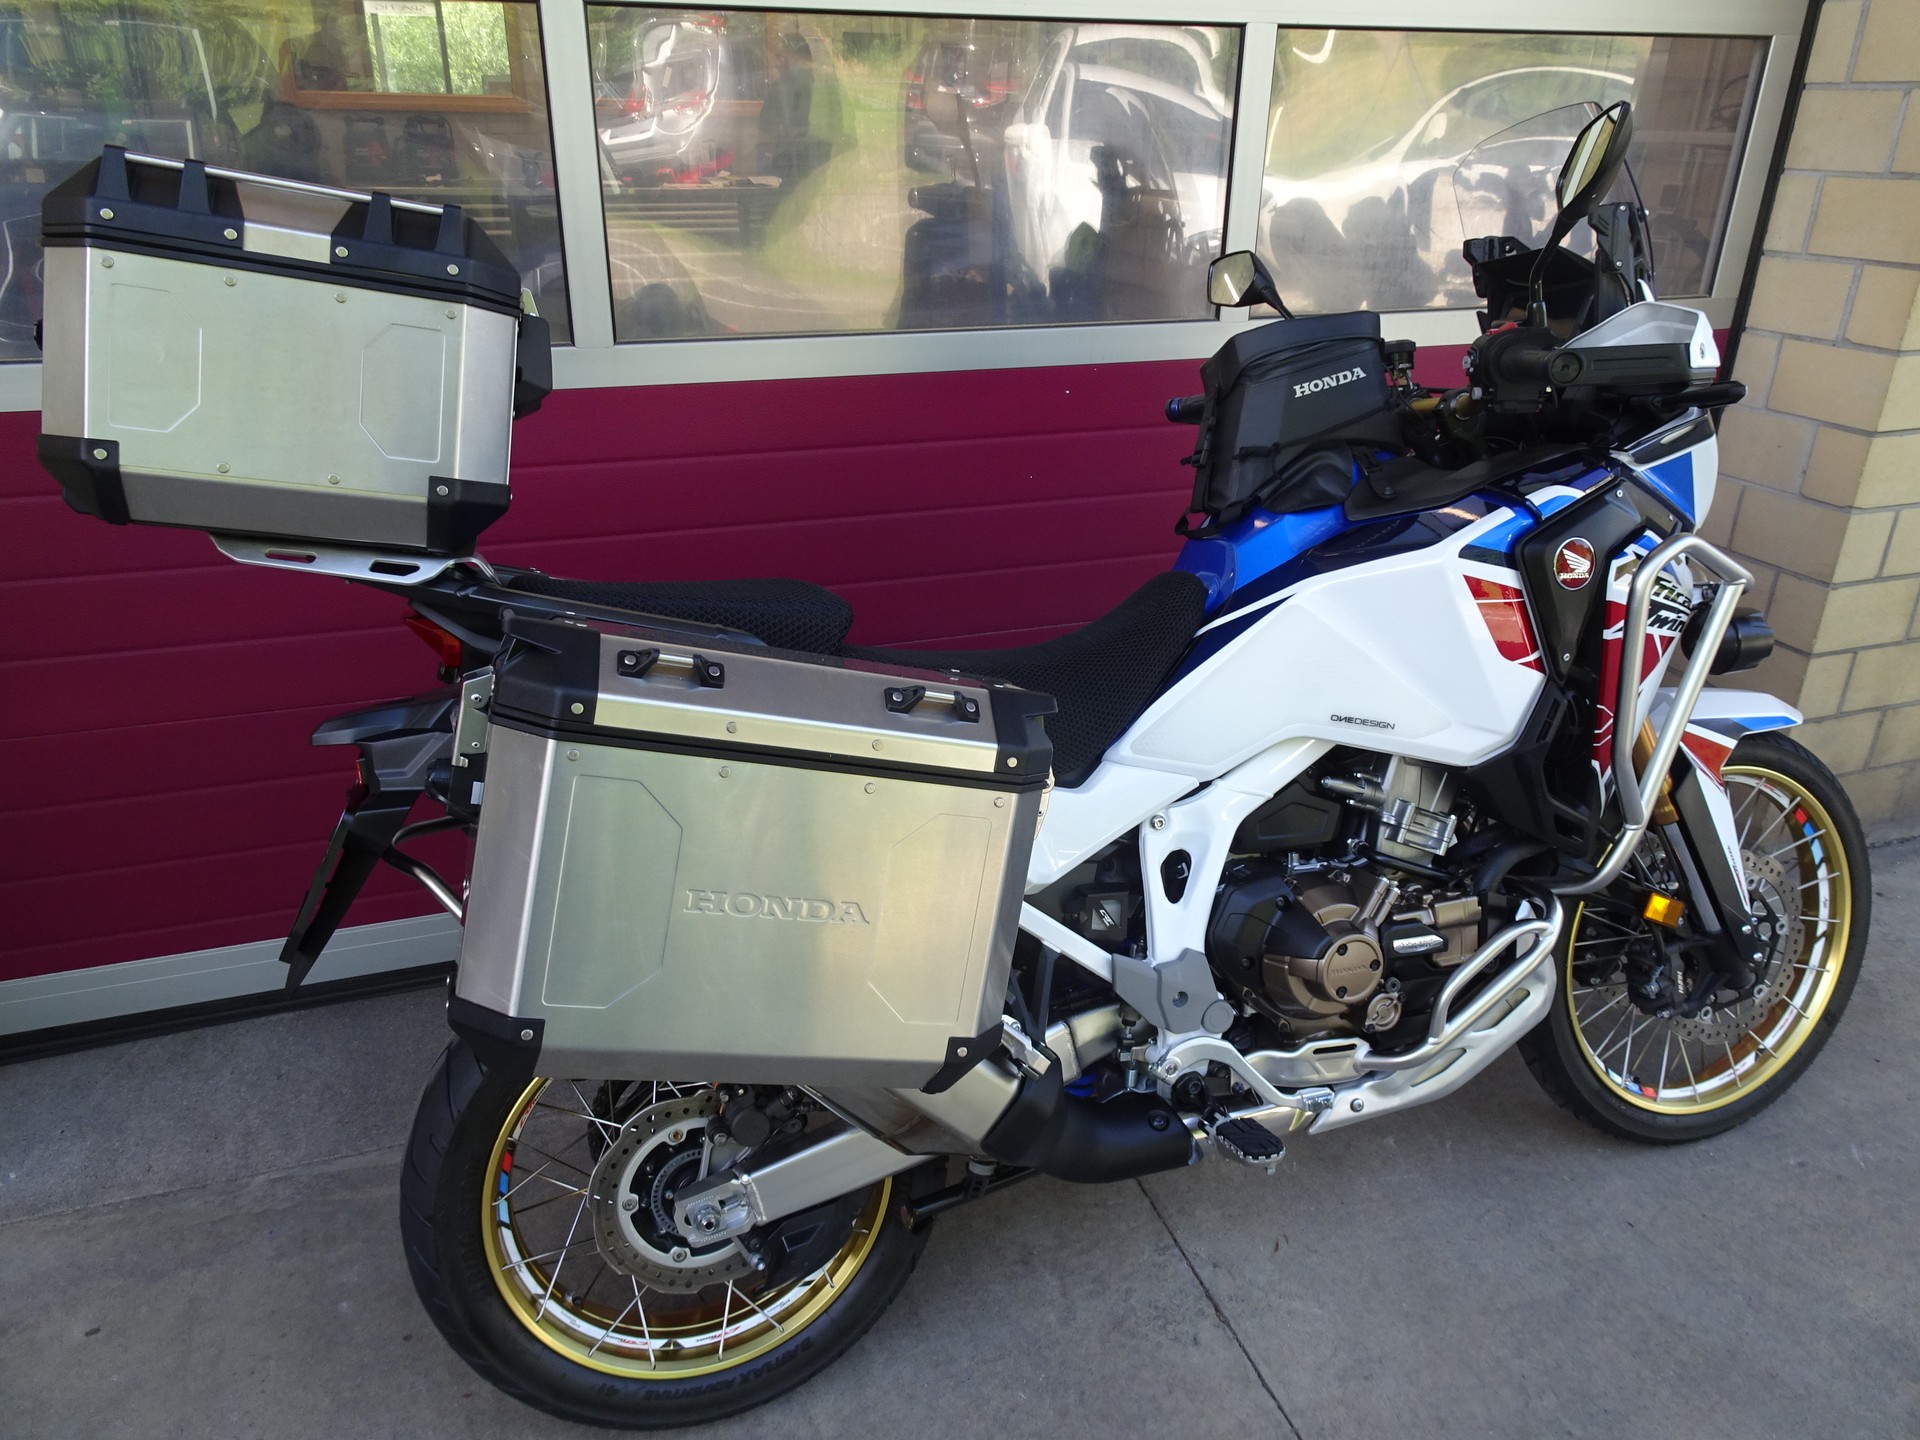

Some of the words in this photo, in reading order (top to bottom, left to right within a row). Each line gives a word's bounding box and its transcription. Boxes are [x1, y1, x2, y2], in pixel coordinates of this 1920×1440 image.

[1293, 366, 1367, 398] HONDA
[1557, 572, 1590, 581] HONDA
[1330, 714, 1396, 730] ONEDESIGN
[683, 889, 871, 925] HONDA
